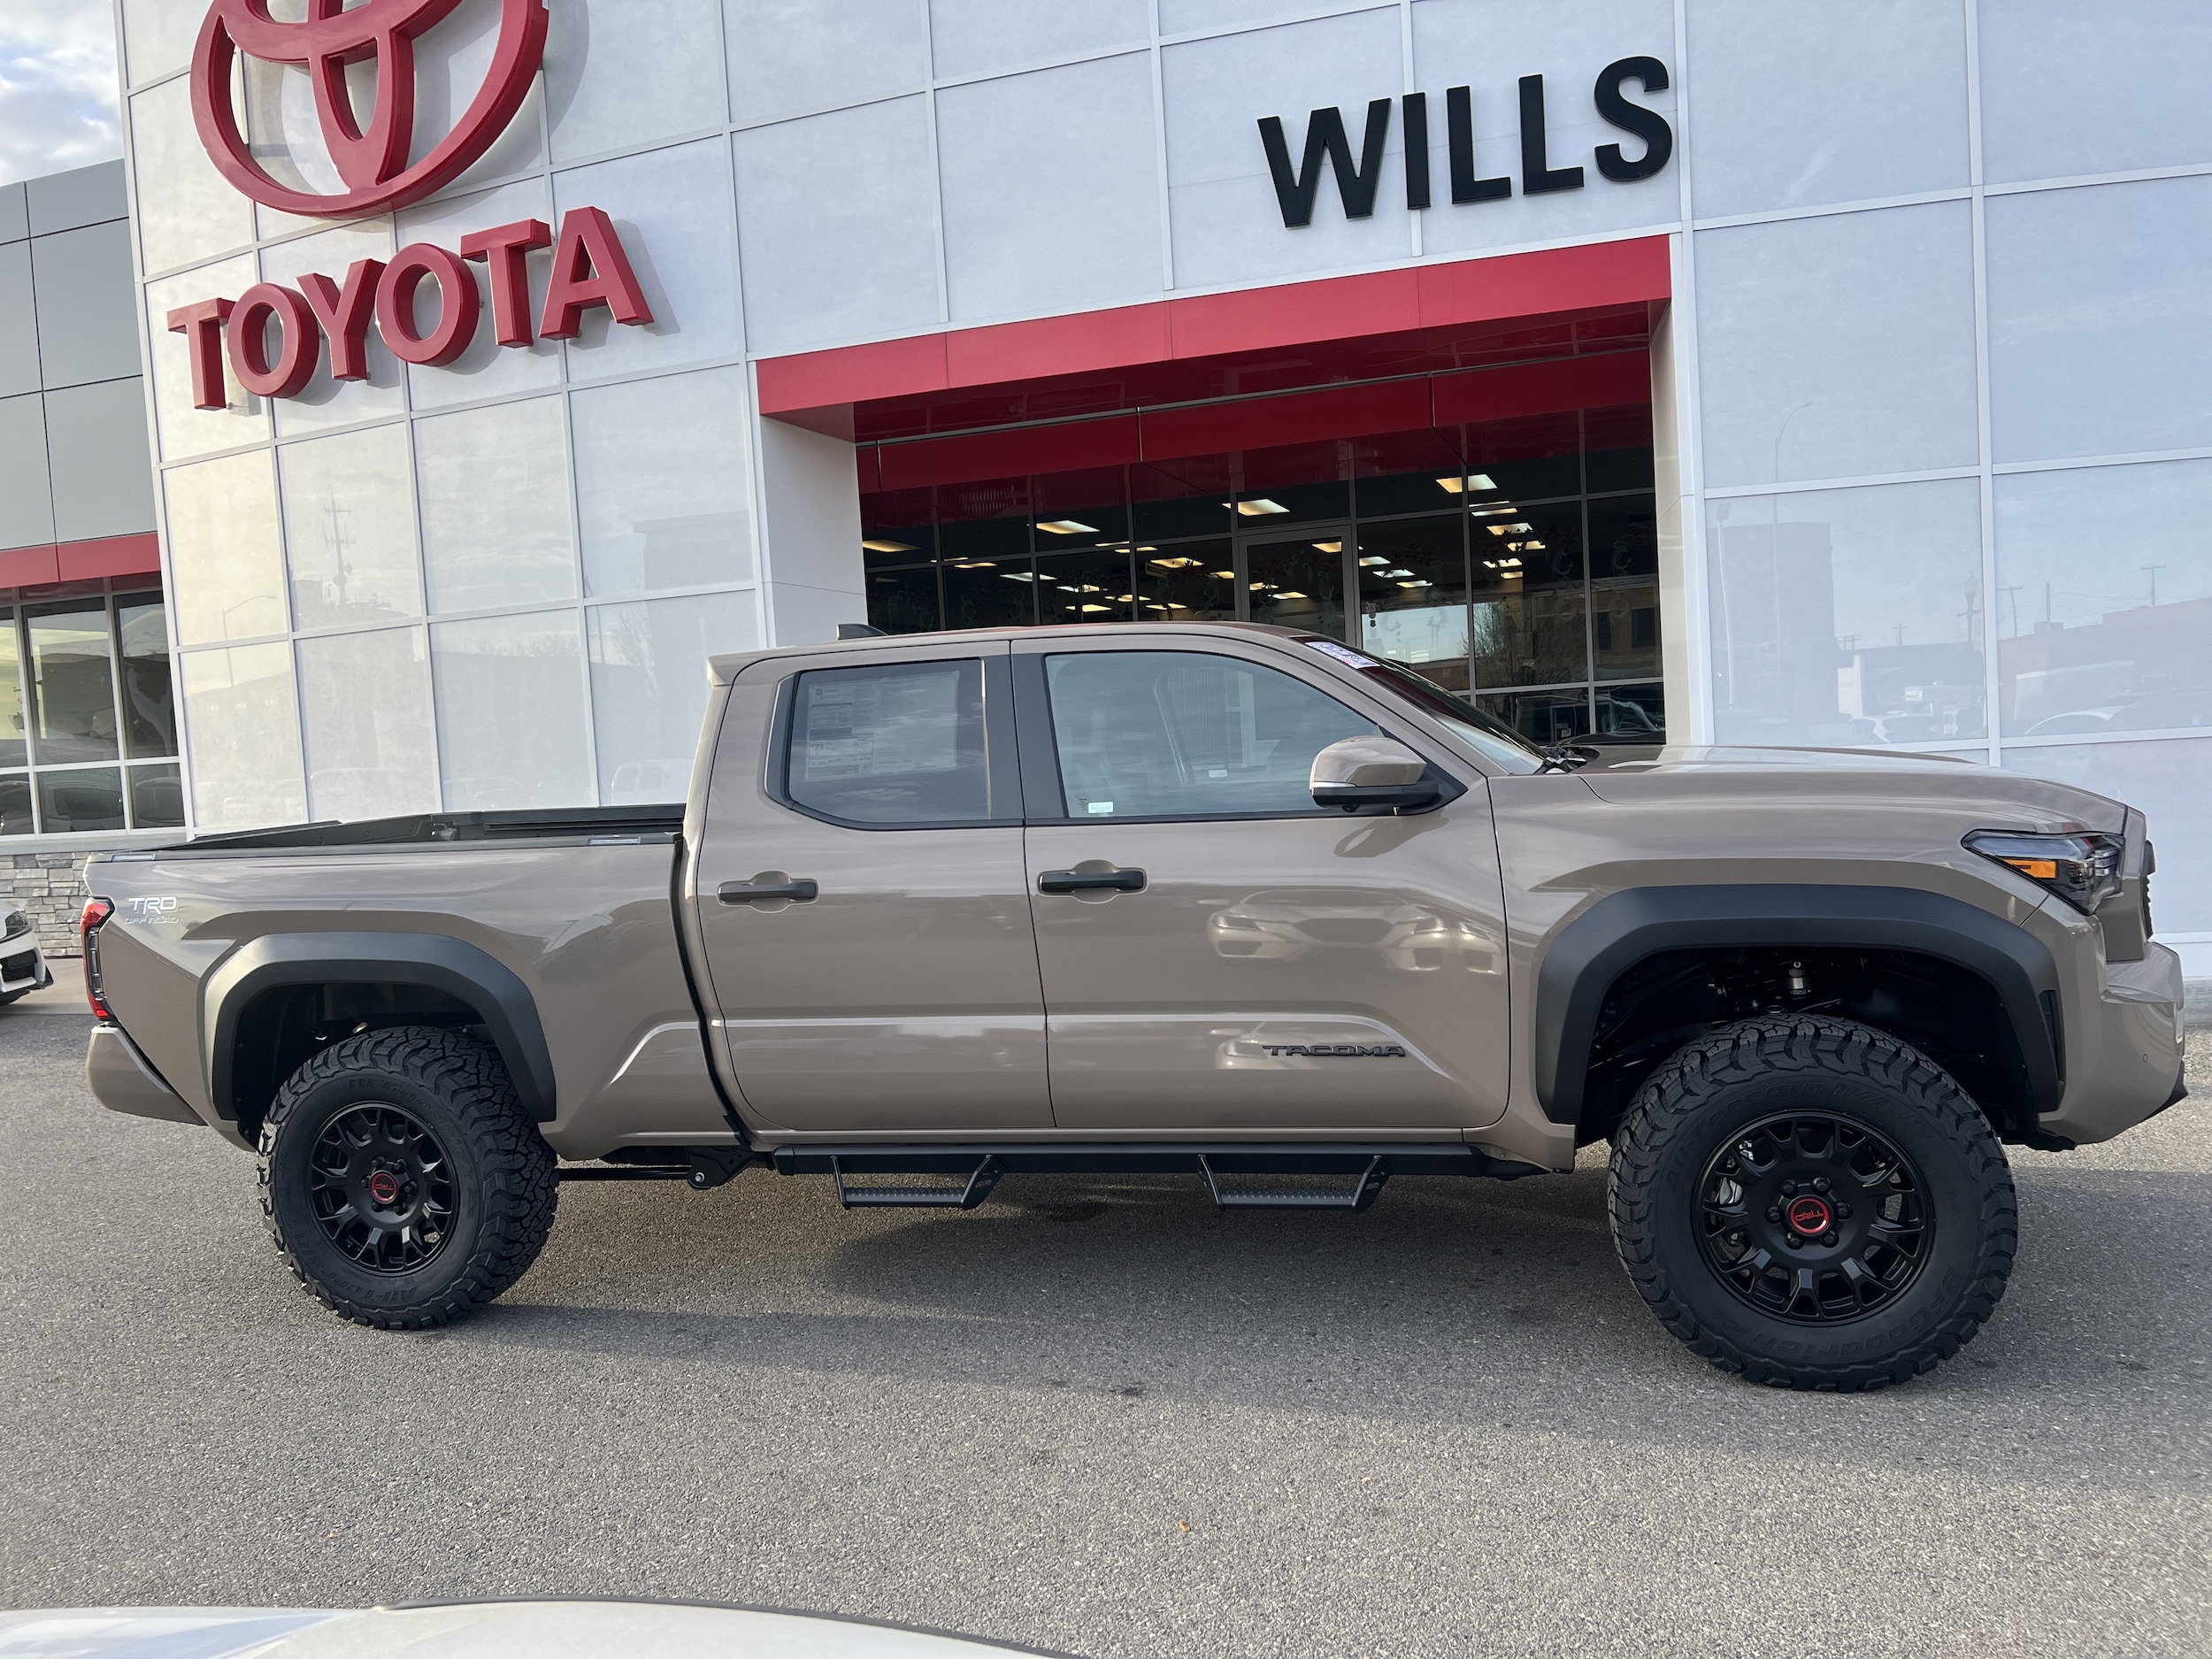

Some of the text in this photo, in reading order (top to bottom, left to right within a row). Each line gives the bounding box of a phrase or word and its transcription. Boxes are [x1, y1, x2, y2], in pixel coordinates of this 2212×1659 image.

[1257, 56, 1672, 227] WILLS
[166, 206, 654, 411] TOYOTA
[127, 896, 177, 915] TRD
[1263, 1045, 1406, 1057] TACOMA
[1794, 1210, 1824, 1222] TRD
